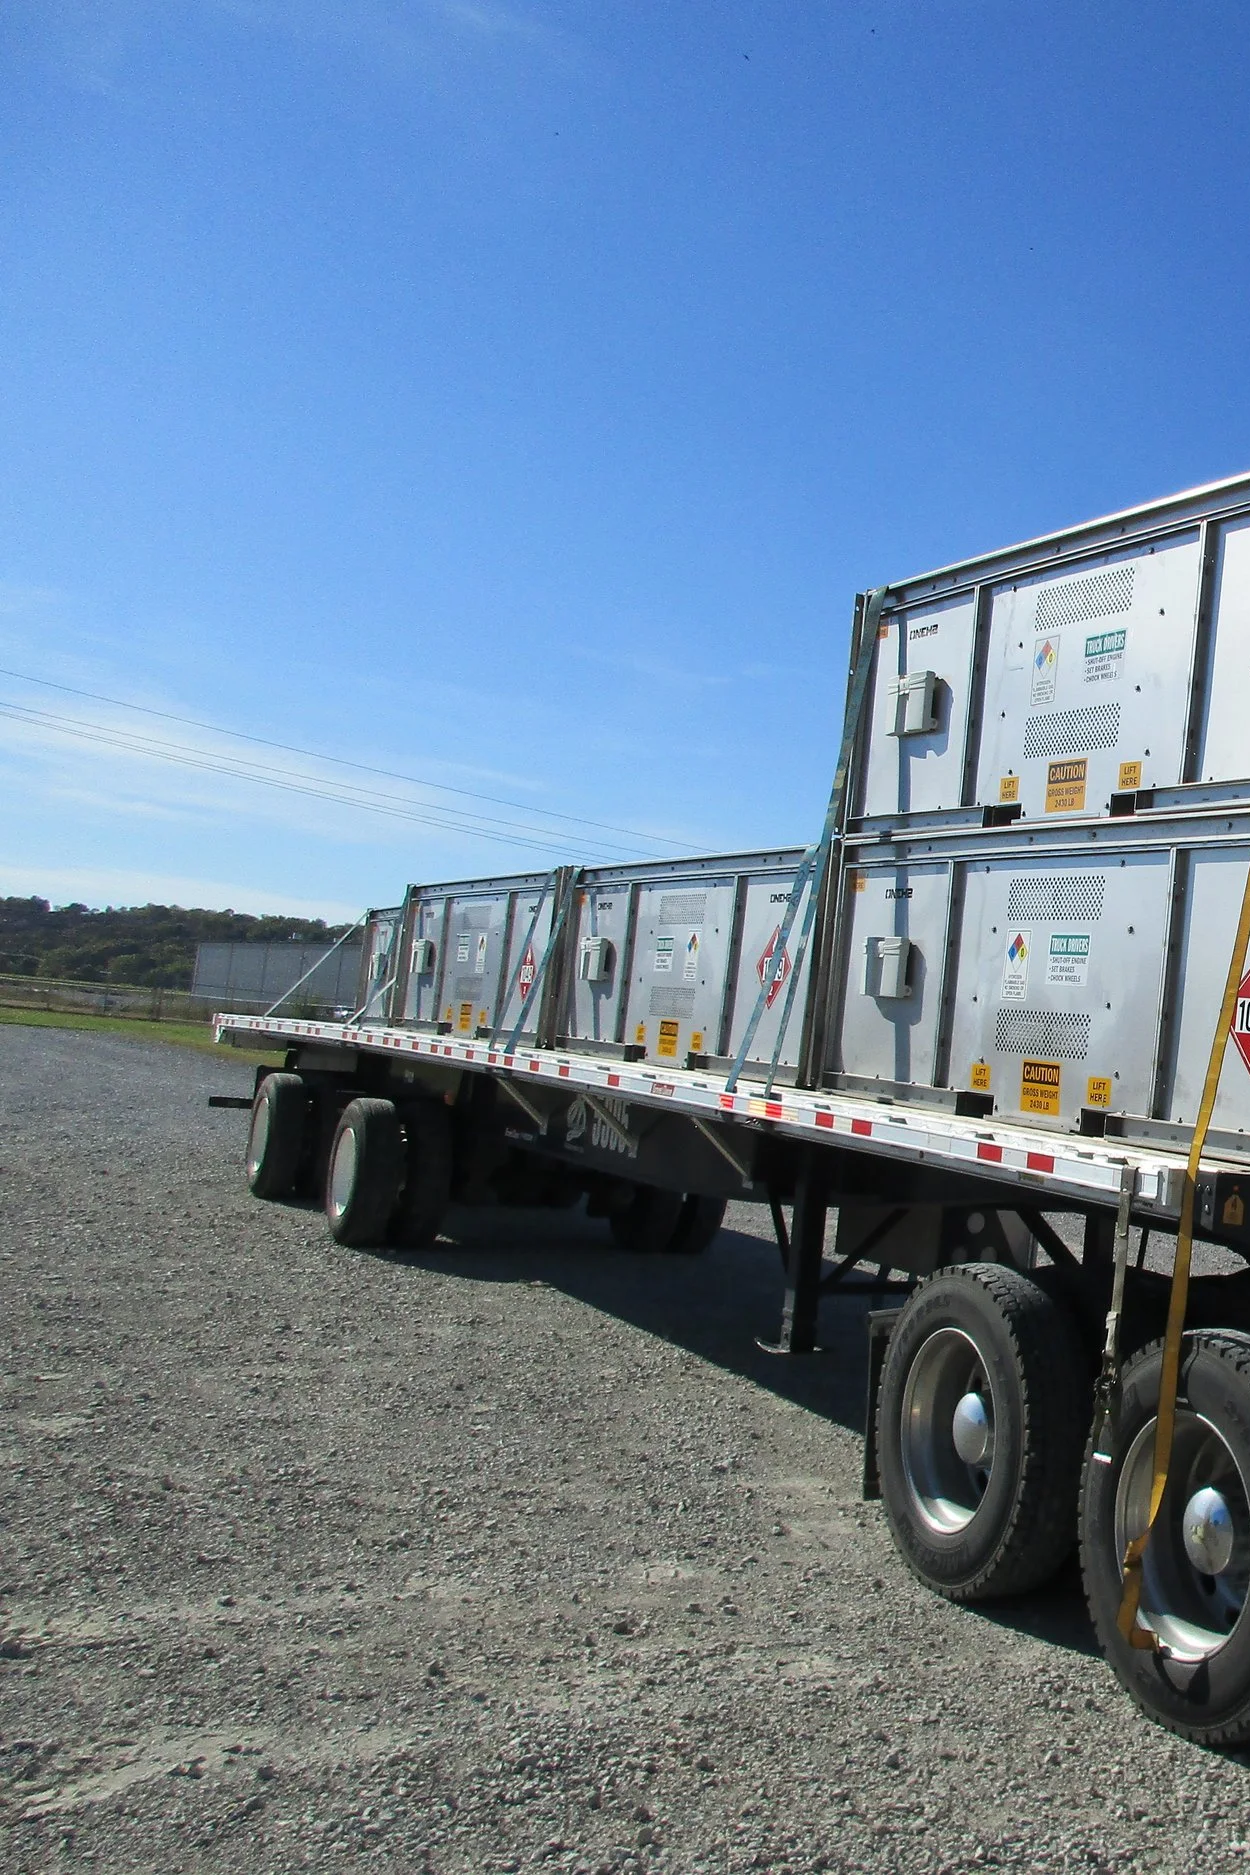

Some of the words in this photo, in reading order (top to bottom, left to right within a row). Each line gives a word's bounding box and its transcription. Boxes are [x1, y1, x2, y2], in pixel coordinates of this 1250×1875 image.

[1087, 637, 1103, 655] TRUCK
[1103, 632, 1125, 650] DRIVERS
[1095, 664, 1111, 673] BRAKES
[1049, 763, 1086, 782] CAUTION
[1124, 765, 1137, 775] LIFT
[1003, 779, 1015, 789] LIFT
[1121, 776, 1138, 786] HERE
[1001, 789, 1016, 799] HERE
[1047, 787, 1065, 798] GROSS
[1065, 785, 1084, 796] WEIGHT
[1054, 798, 1067, 809] 2430
[1068, 797, 1075, 807] LB
[1051, 938, 1068, 953] TRUCK
[1068, 938, 1089, 953] DRIVERS
[1059, 965, 1075, 974] BRAKES
[1064, 975, 1081, 983] WHEELS
[975, 1068, 986, 1076] LIFT
[1024, 1065, 1059, 1083] CAUTION
[972, 1078, 987, 1087] HERE
[1092, 1081, 1106, 1091] LIFT
[1022, 1086, 1039, 1097] GROSS
[1040, 1088, 1058, 1100] WEIGHT
[1089, 1093, 1107, 1103] HERE
[1029, 1099, 1043, 1110] 2430
[1043, 1100, 1050, 1110] LB
